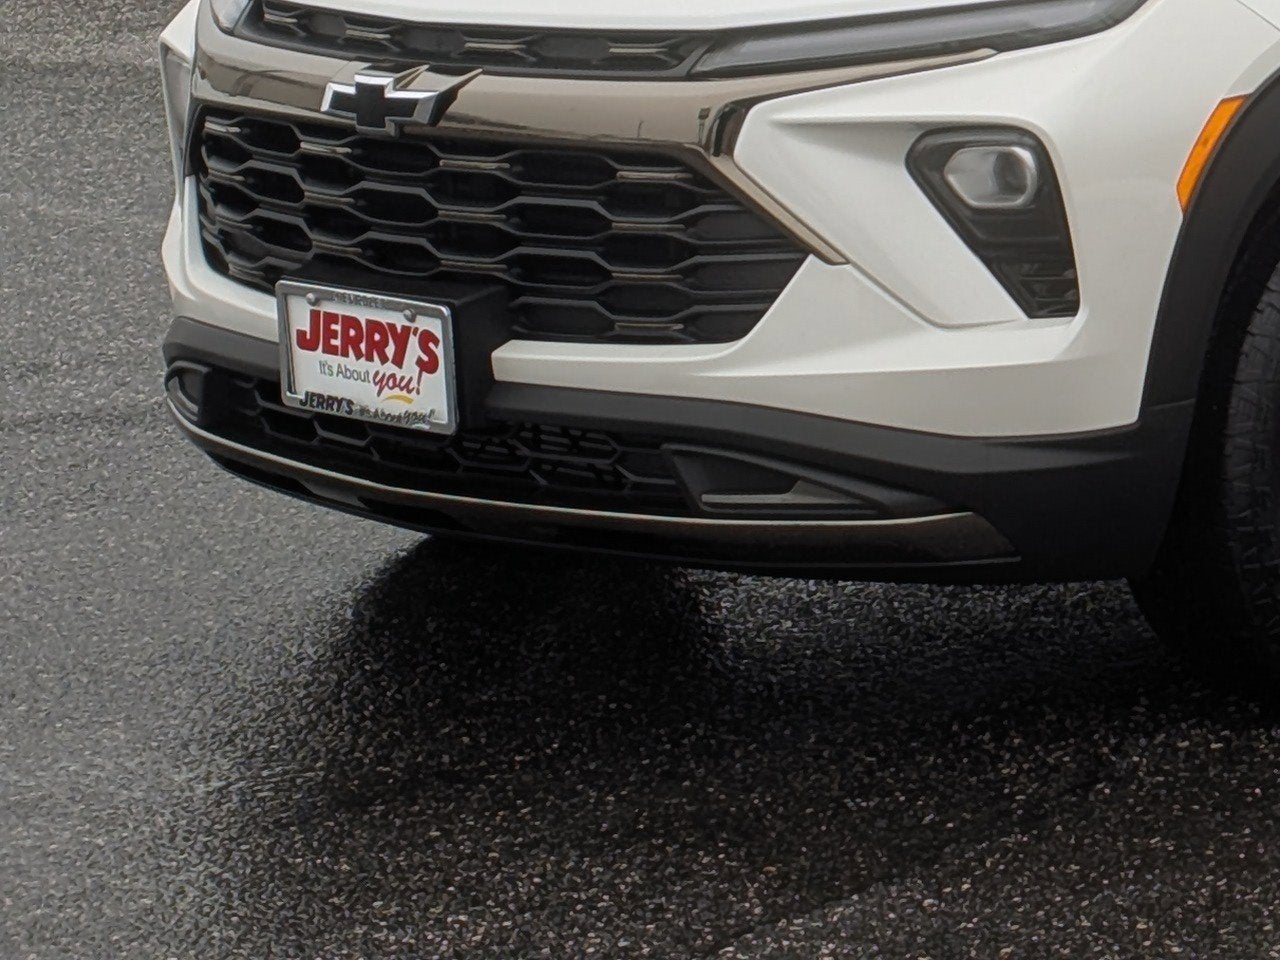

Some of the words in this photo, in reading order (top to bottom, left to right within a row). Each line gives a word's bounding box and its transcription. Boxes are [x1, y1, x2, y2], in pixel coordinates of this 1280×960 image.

[296, 309, 440, 375] JERRY'S
[319, 360, 334, 378] It's
[336, 362, 371, 384] About
[372, 367, 423, 398] you!
